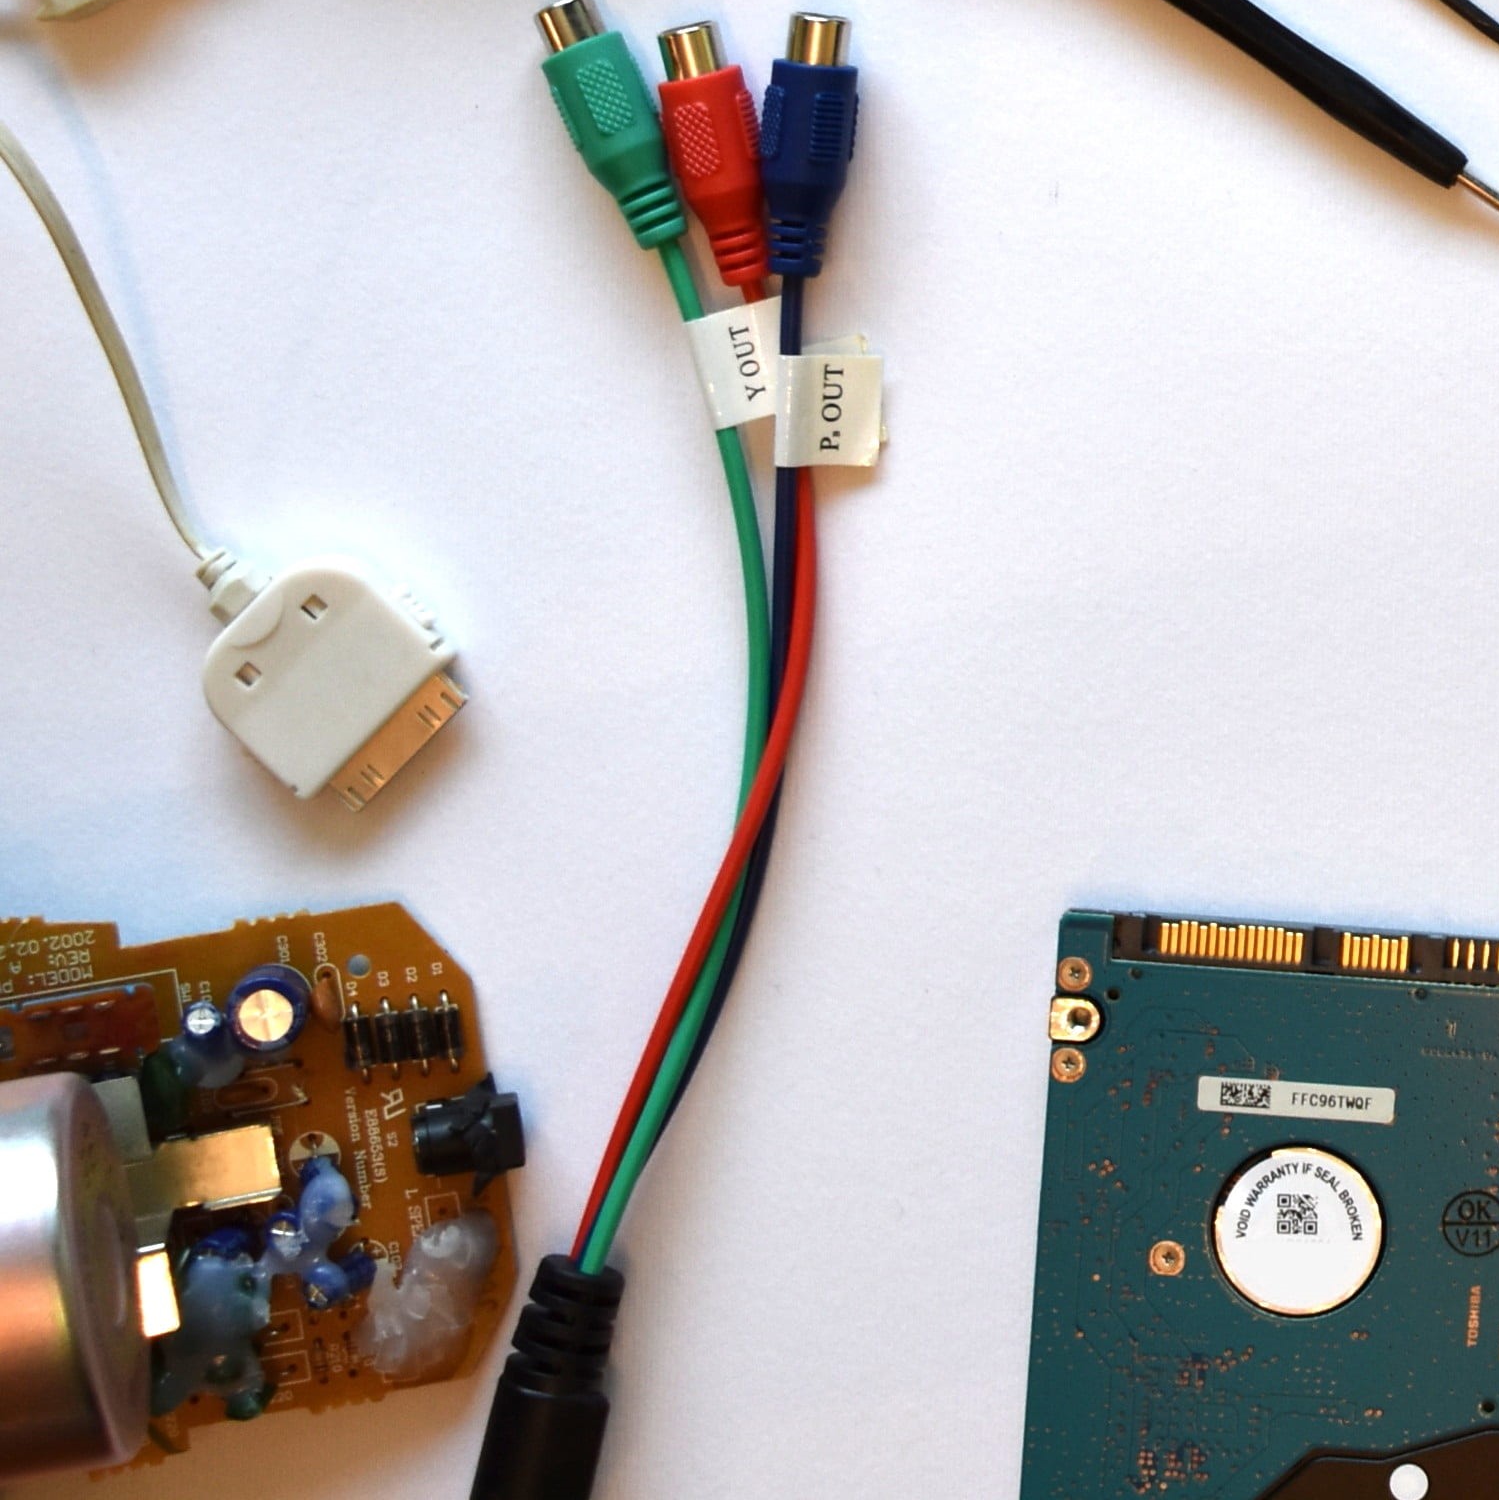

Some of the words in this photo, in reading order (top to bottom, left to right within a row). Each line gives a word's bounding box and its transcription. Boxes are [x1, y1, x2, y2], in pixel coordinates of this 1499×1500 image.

[728, 325, 762, 378] OUT
[745, 386, 767, 402] Y
[821, 363, 845, 424] OUT
[819, 430, 841, 452] P.
[27, 964, 93, 987] MODEL:
[1291, 1091, 1373, 1111] FFC96TWQF
[344, 1086, 361, 1142] Version
[353, 1149, 372, 1209] Number
[1235, 1207, 1251, 1238] VOID
[1244, 1161, 1299, 1207] WARRANTY
[1301, 1161, 1313, 1173] IF
[1313, 1165, 1341, 1192] SEAL
[1337, 1189, 1363, 1241] BROKEN
[1457, 1200, 1492, 1221] OK
[1456, 1229, 1493, 1248] V11
[1466, 1284, 1482, 1348] TOSHIBA
